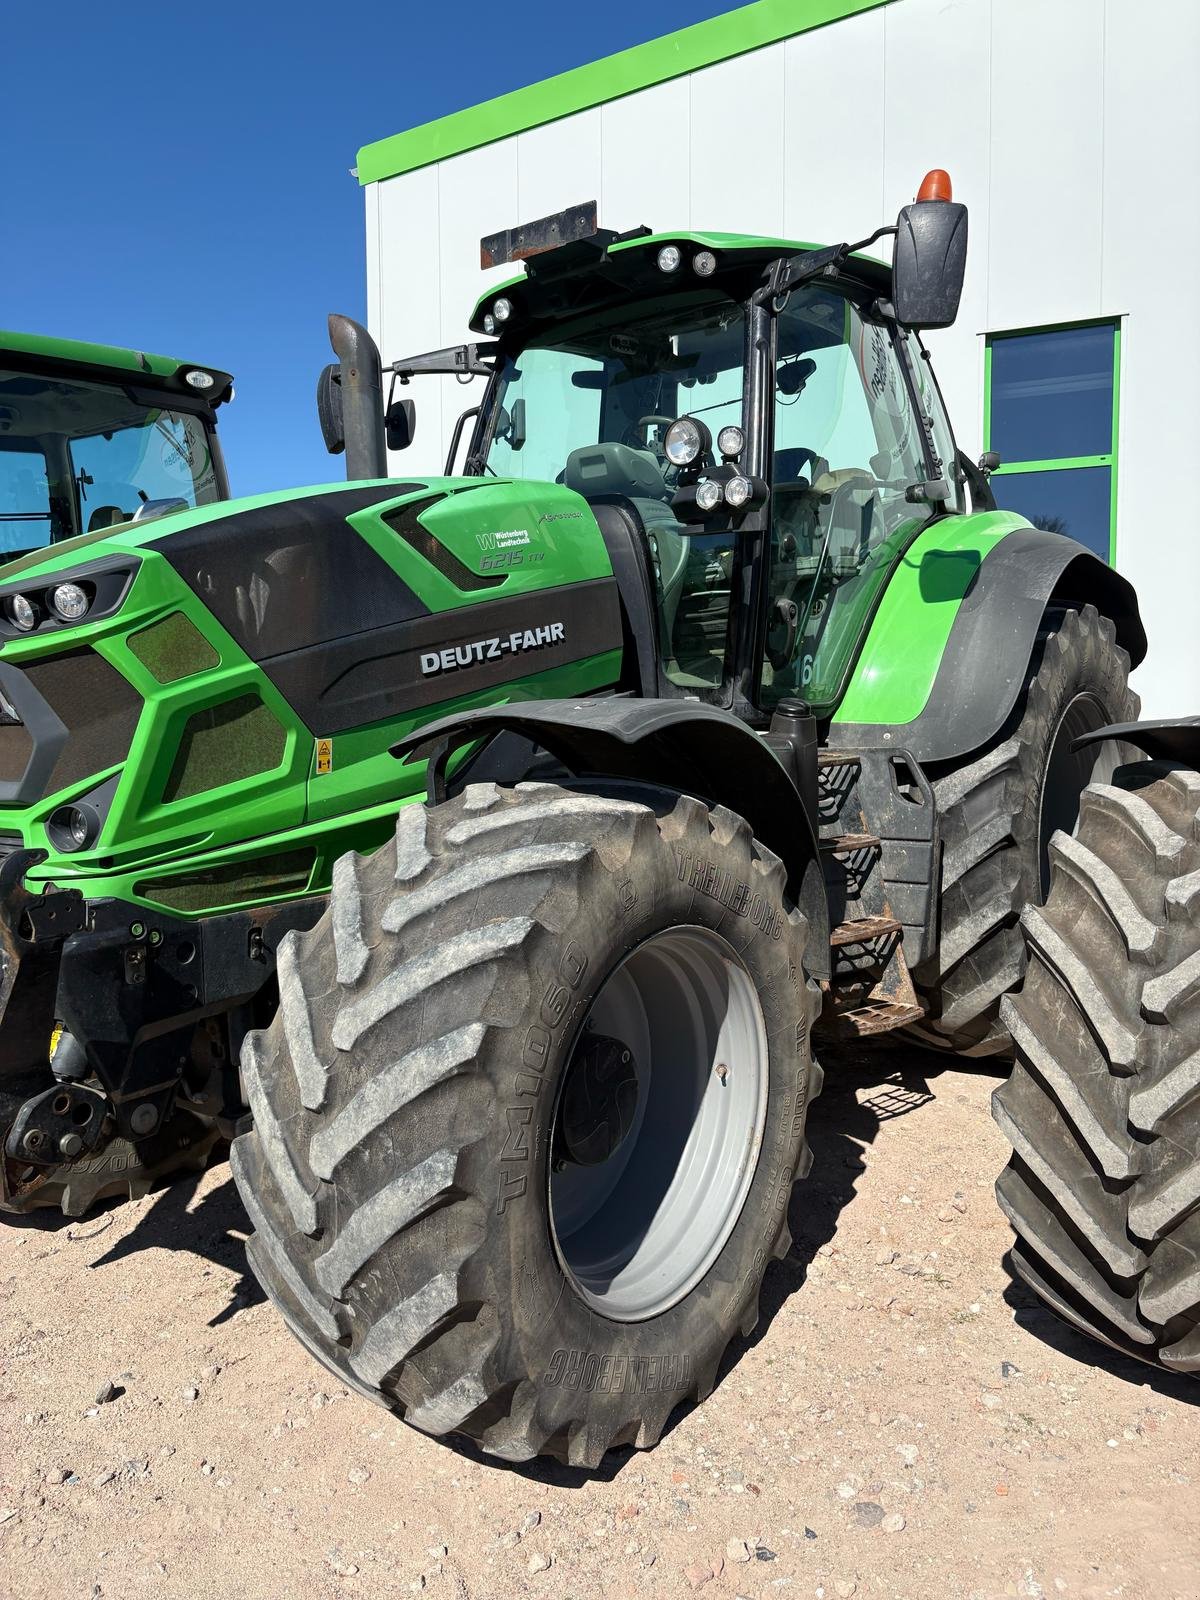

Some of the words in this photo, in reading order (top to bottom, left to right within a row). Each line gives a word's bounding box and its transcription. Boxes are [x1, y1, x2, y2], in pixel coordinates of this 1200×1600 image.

[480, 550, 523, 571] 6215
[528, 552, 545, 562] TTV
[497, 537, 530, 547] Landtechnik
[420, 622, 566, 676] DEUTZ-FAHR
[677, 847, 784, 941] TRELLEBORG
[497, 939, 589, 1216] TM1060
[543, 1348, 691, 1396] TRELLEBORG
